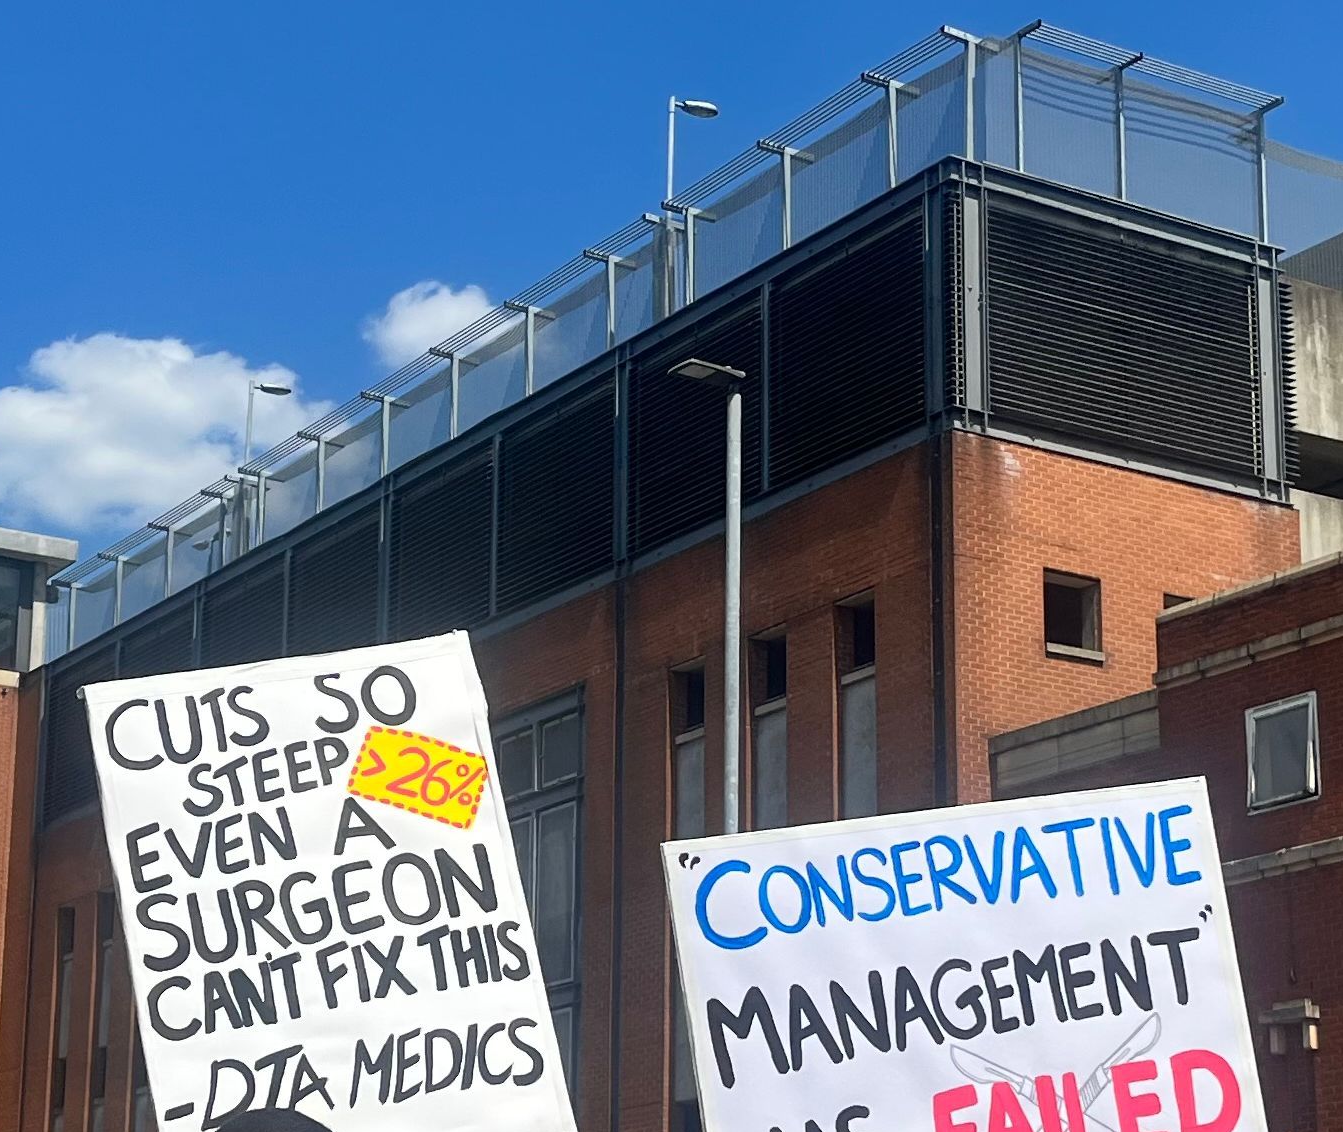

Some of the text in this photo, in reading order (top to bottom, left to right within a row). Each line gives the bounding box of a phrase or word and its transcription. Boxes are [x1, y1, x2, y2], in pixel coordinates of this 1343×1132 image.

[105, 665, 416, 770] CUTS SO
[183, 736, 349, 816] STEEP
[361, 746, 486, 808] >26%
[126, 798, 397, 893] EVEN A
[137, 844, 498, 971] SURGEON
[317, 936, 417, 1009] FIX
[417, 921, 530, 991] THIS
[349, 1018, 544, 1108] MEDICS
